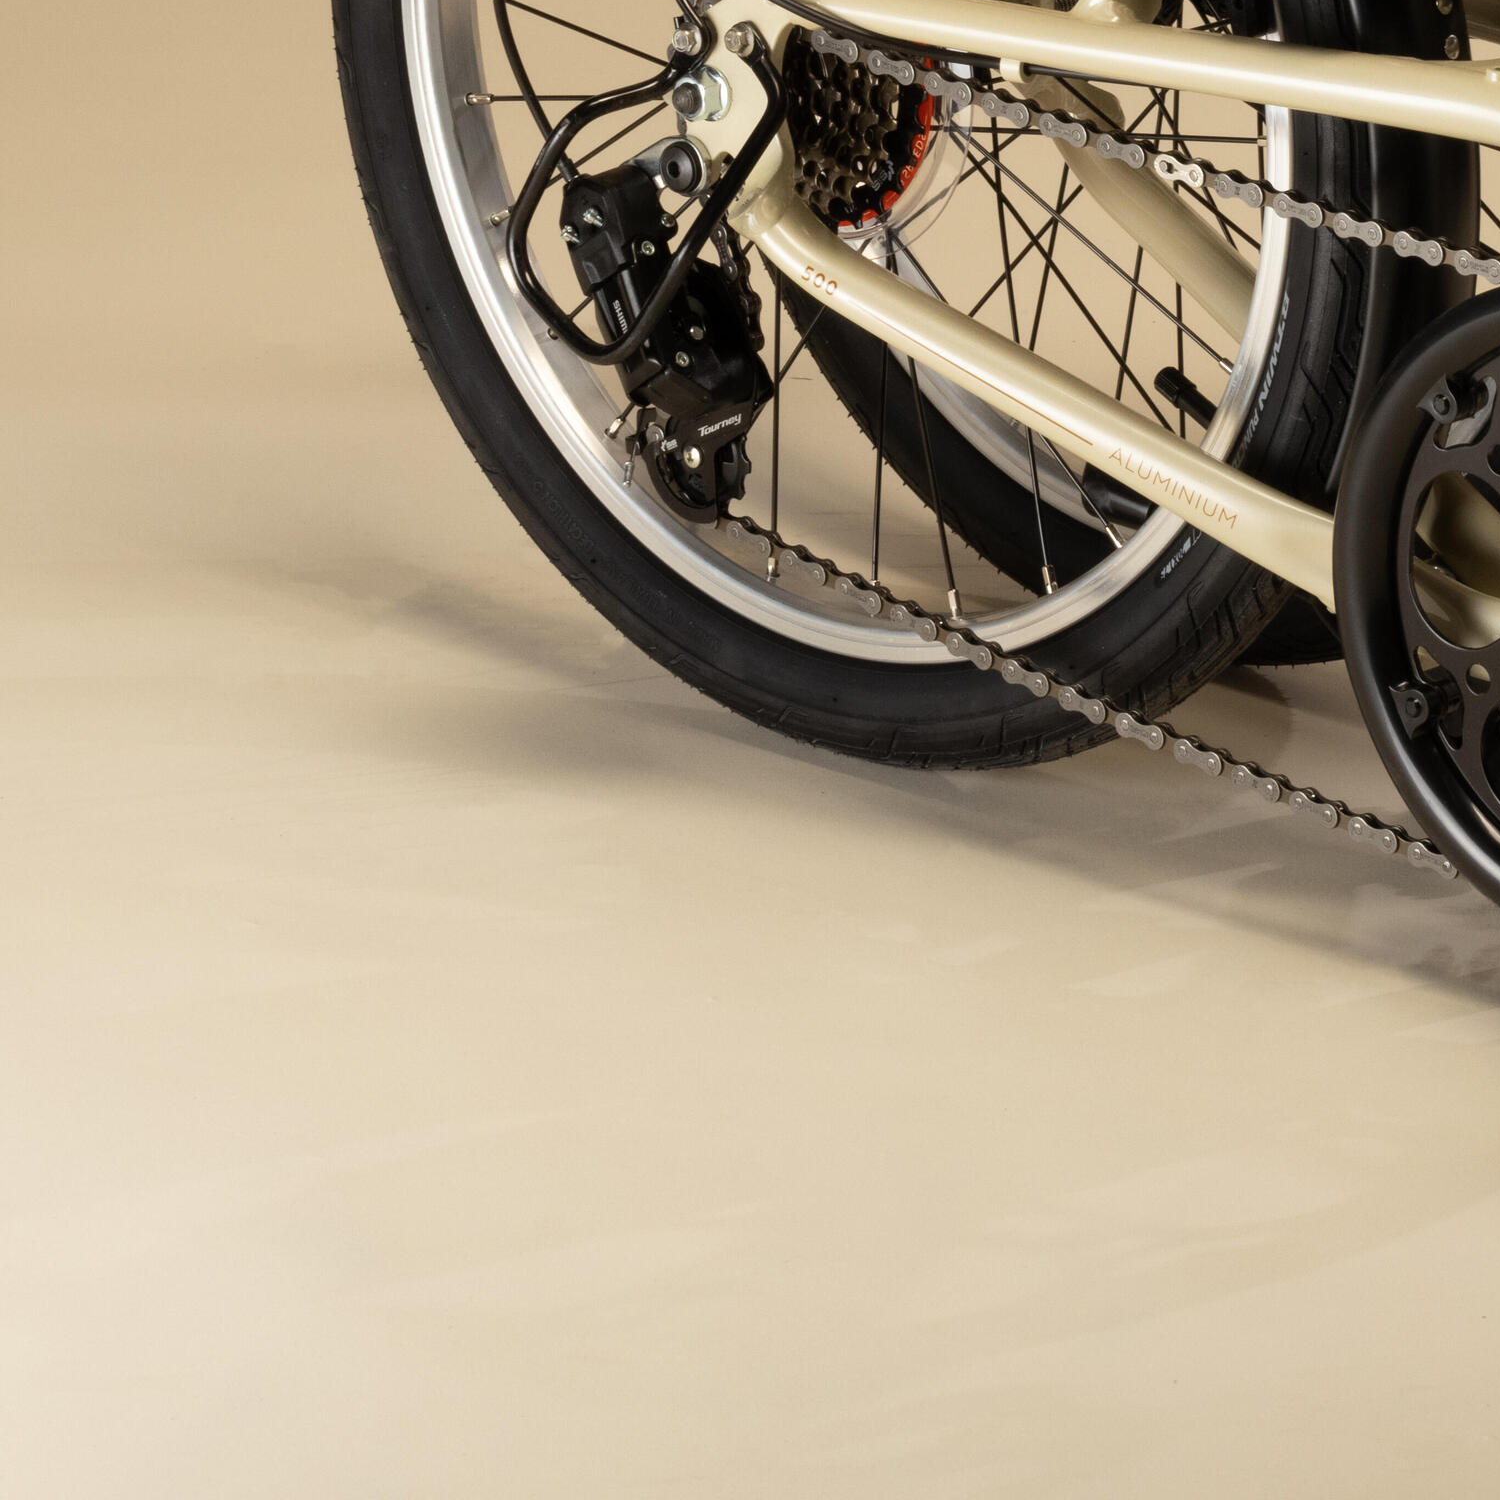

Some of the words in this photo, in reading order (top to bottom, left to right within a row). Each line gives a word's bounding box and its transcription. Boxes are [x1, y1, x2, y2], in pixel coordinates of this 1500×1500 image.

[800, 265, 840, 298] 500
[613, 299, 630, 335] SHIM
[696, 412, 744, 438] Tourney
[1108, 446, 1240, 530] ALUMINIUM
